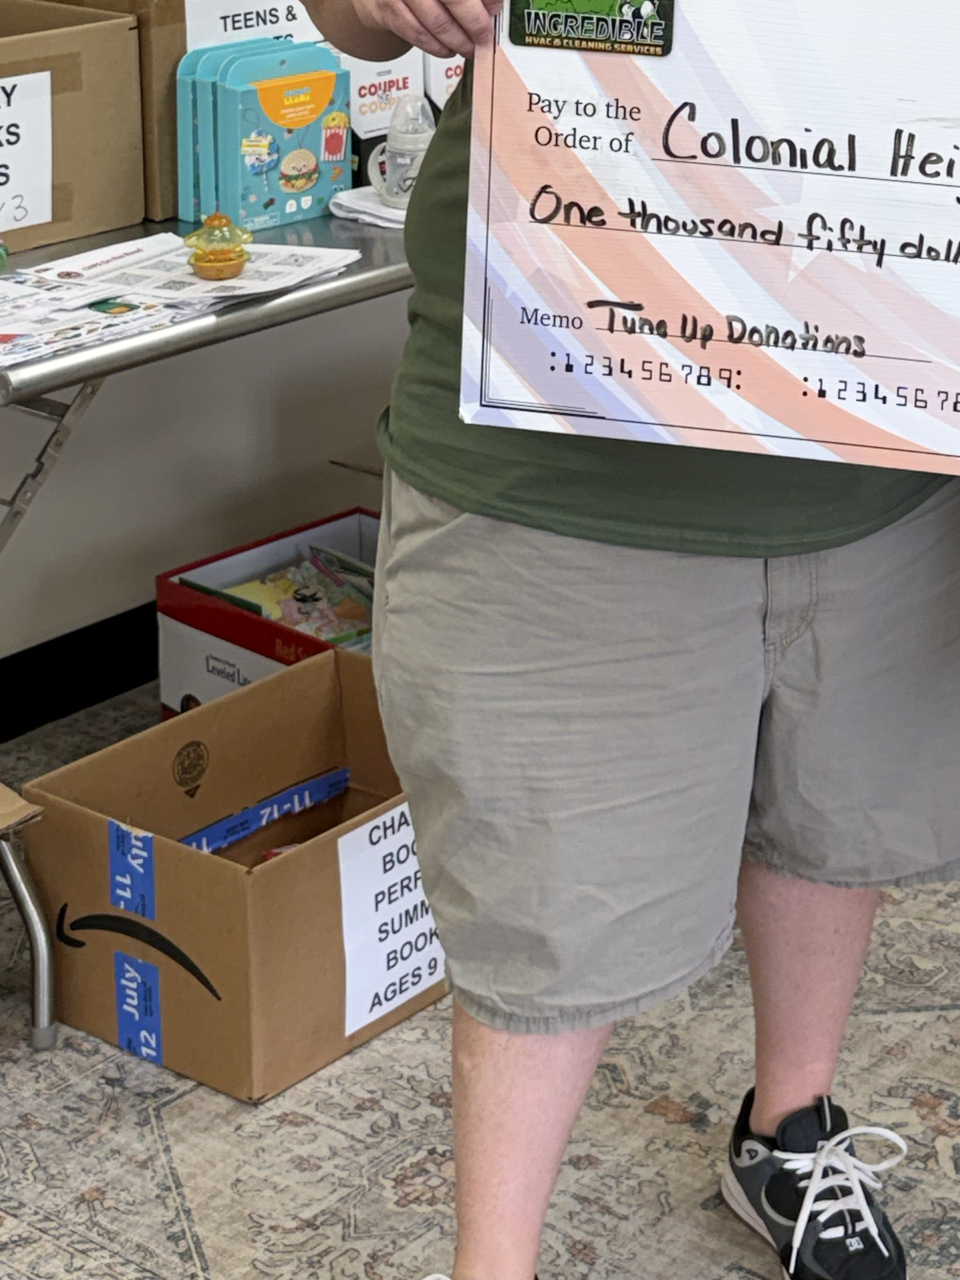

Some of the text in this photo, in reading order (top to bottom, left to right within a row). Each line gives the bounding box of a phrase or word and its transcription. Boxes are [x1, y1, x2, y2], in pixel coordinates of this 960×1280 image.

[220, 5, 298, 32] TEENS &
[524, 9, 665, 46] INCREDIBLE
[525, 36, 663, 55] HVAC & CLEANING SERVICES
[358, 76, 409, 98] COUPLE
[527, 93, 641, 121] Pay to the
[534, 126, 635, 153] Order of
[662, 101, 856, 173] Colonial
[528, 184, 607, 228] One
[617, 197, 783, 247] thousand
[797, 212, 886, 268] fifty
[520, 306, 583, 330] Memo
[587, 300, 867, 359] Tune Up Donations
[206, 655, 235, 683] Leveled
[386, 926, 440, 971] BOOK
[121, 962, 142, 1021] July
[369, 956, 438, 1014] AGES 9
